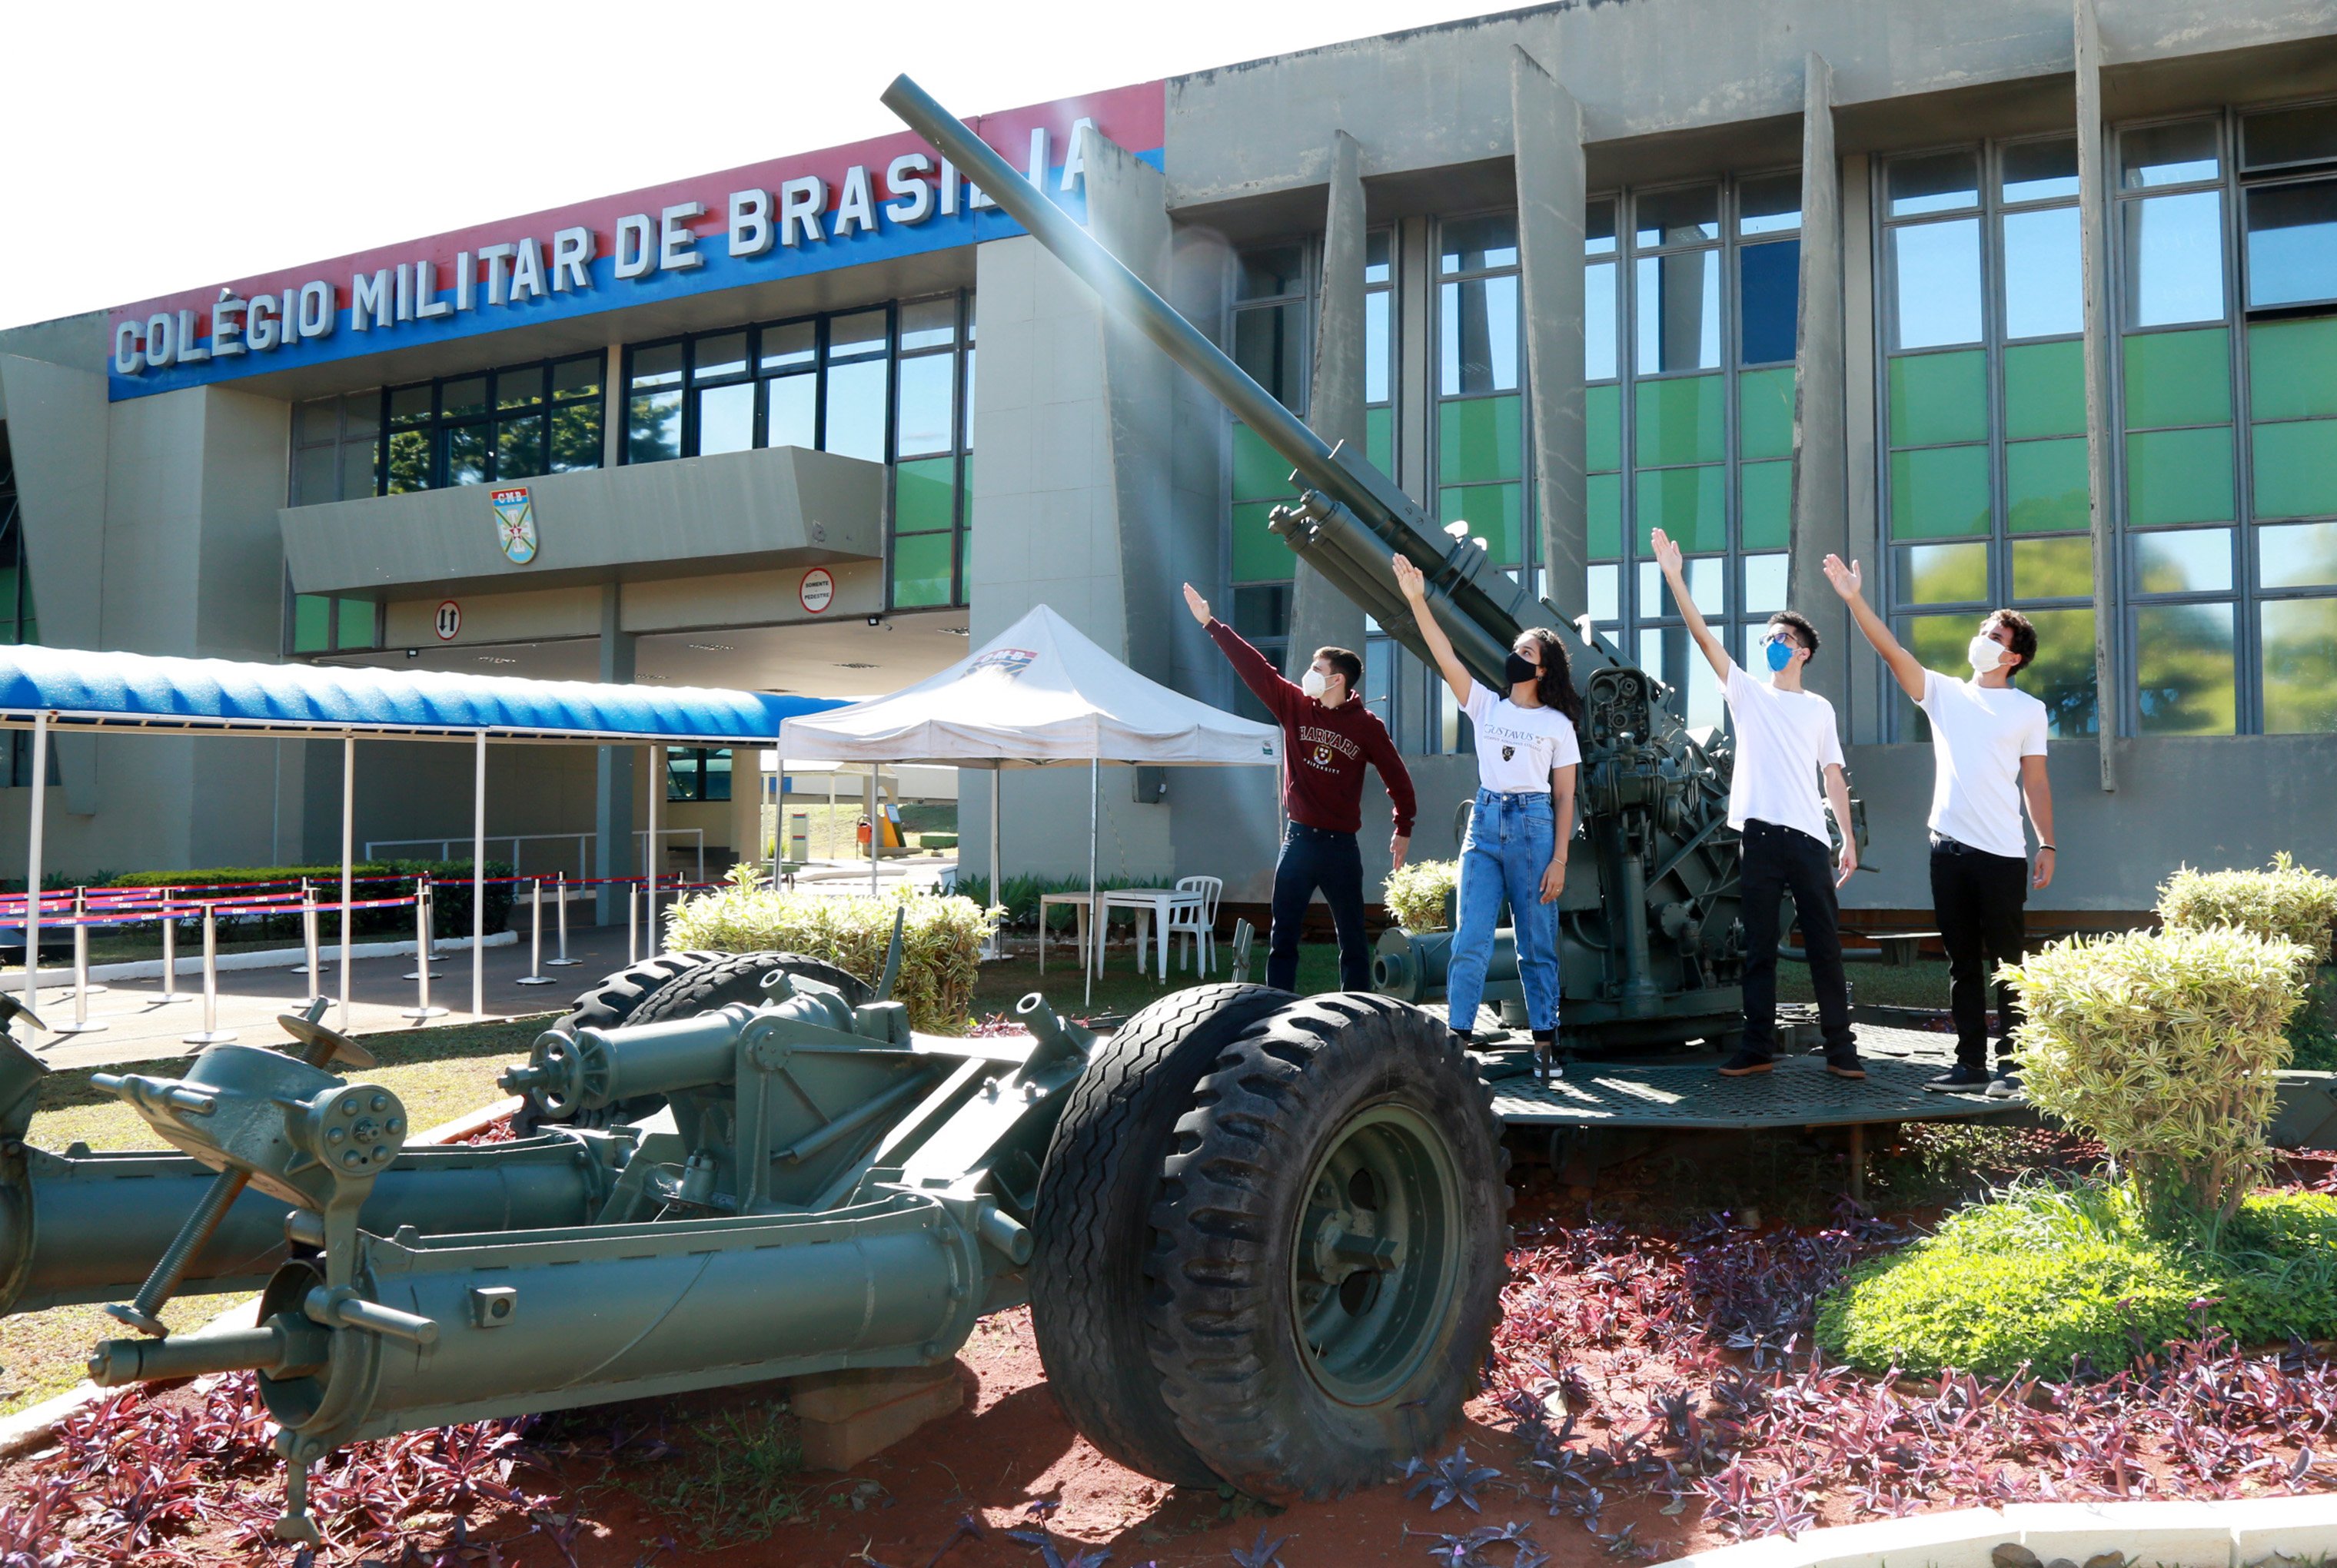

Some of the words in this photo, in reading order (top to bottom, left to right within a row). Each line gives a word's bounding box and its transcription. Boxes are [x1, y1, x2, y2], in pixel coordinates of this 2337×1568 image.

[114, 281, 335, 376] COLÉGIO
[351, 225, 595, 332] MILITAR
[614, 201, 706, 280] DE
[498, 491, 523, 503] CMB
[1484, 723, 1534, 741] GUSTAVUS
